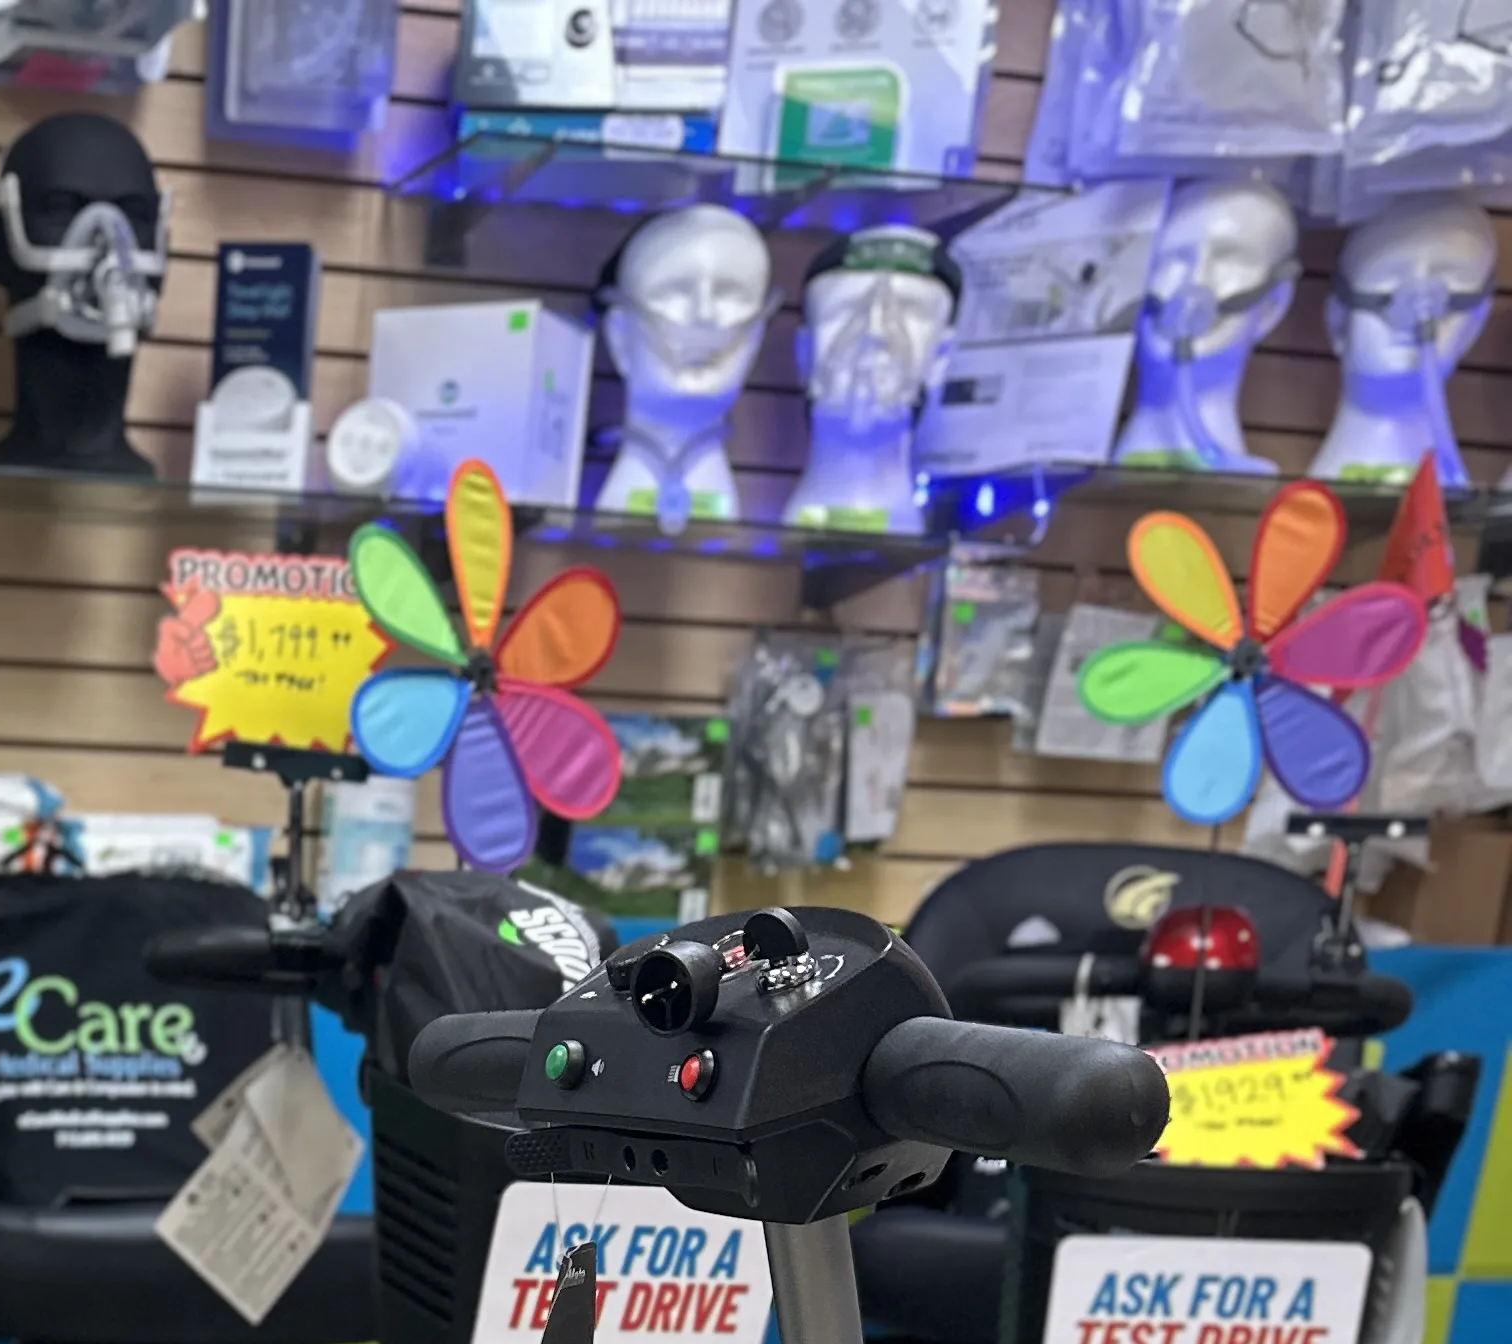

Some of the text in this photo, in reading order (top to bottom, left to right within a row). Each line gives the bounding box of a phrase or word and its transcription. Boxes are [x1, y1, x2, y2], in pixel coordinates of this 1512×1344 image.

[621, 1225, 707, 1277] FOR
[709, 1229, 743, 1278] A
[508, 1279, 750, 1334] TET DRIVE
[1088, 1270, 1316, 1322] ASK FOR A
